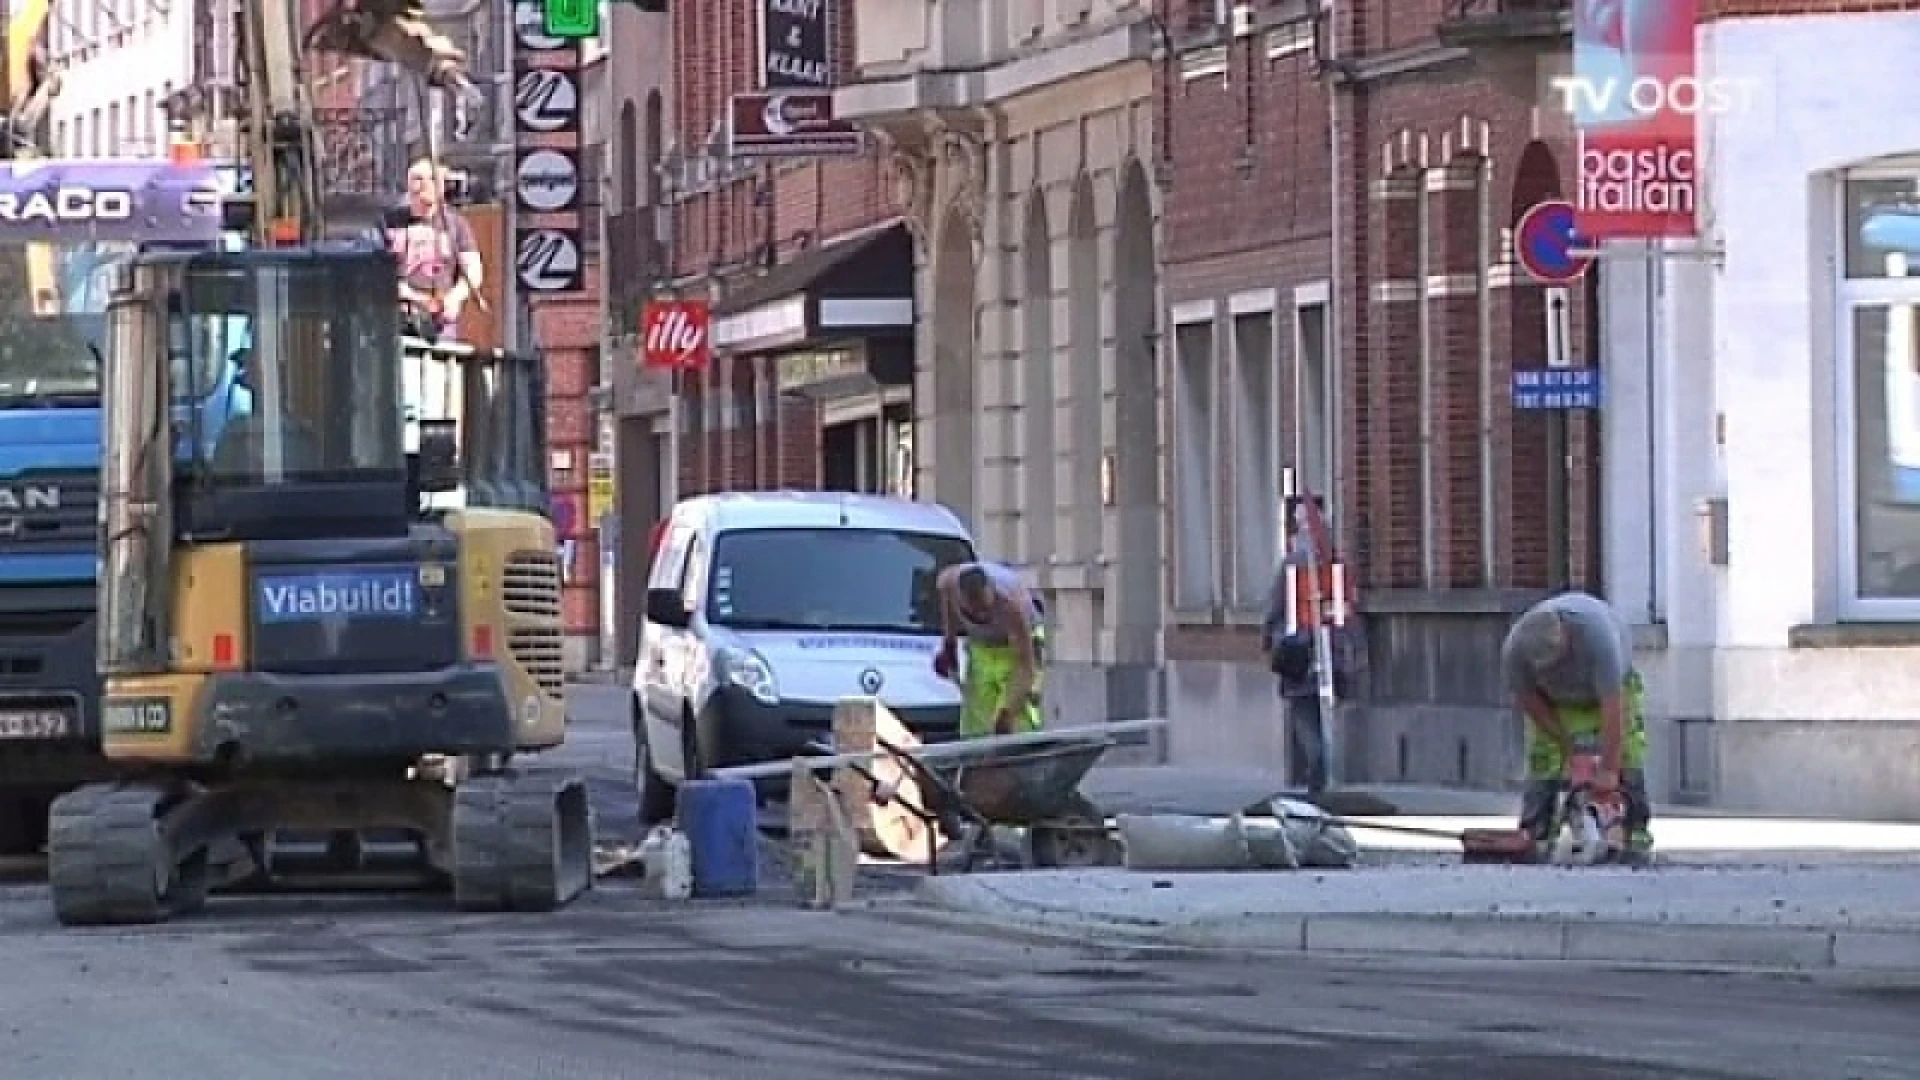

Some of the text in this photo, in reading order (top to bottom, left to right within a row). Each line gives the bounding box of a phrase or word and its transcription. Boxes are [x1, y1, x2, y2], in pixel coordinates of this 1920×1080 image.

[1578, 130, 1693, 180] basic
[1578, 176, 1693, 212] italian
[647, 310, 702, 361] illy
